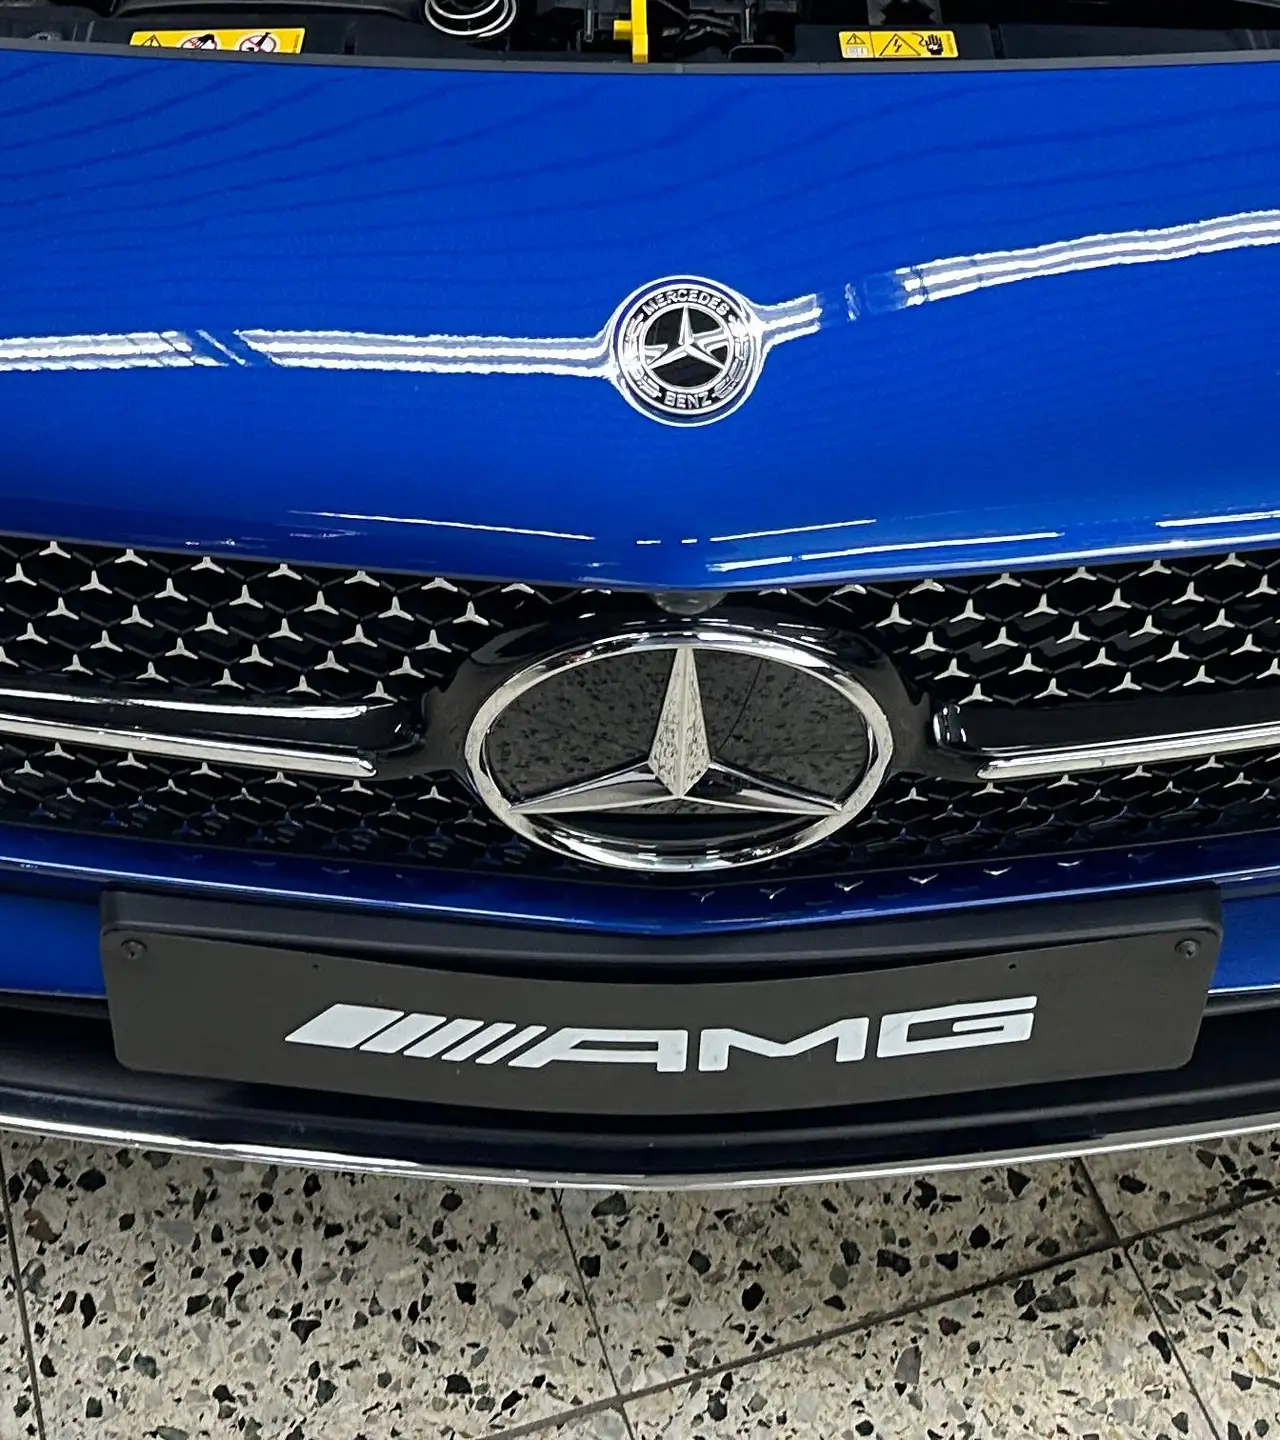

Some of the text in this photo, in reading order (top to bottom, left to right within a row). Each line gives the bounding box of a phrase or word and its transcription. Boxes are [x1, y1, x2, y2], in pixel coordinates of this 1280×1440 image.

[642, 288, 731, 317] MERCEDES
[663, 390, 714, 410] BENZ
[510, 995, 1038, 1074] AMG
